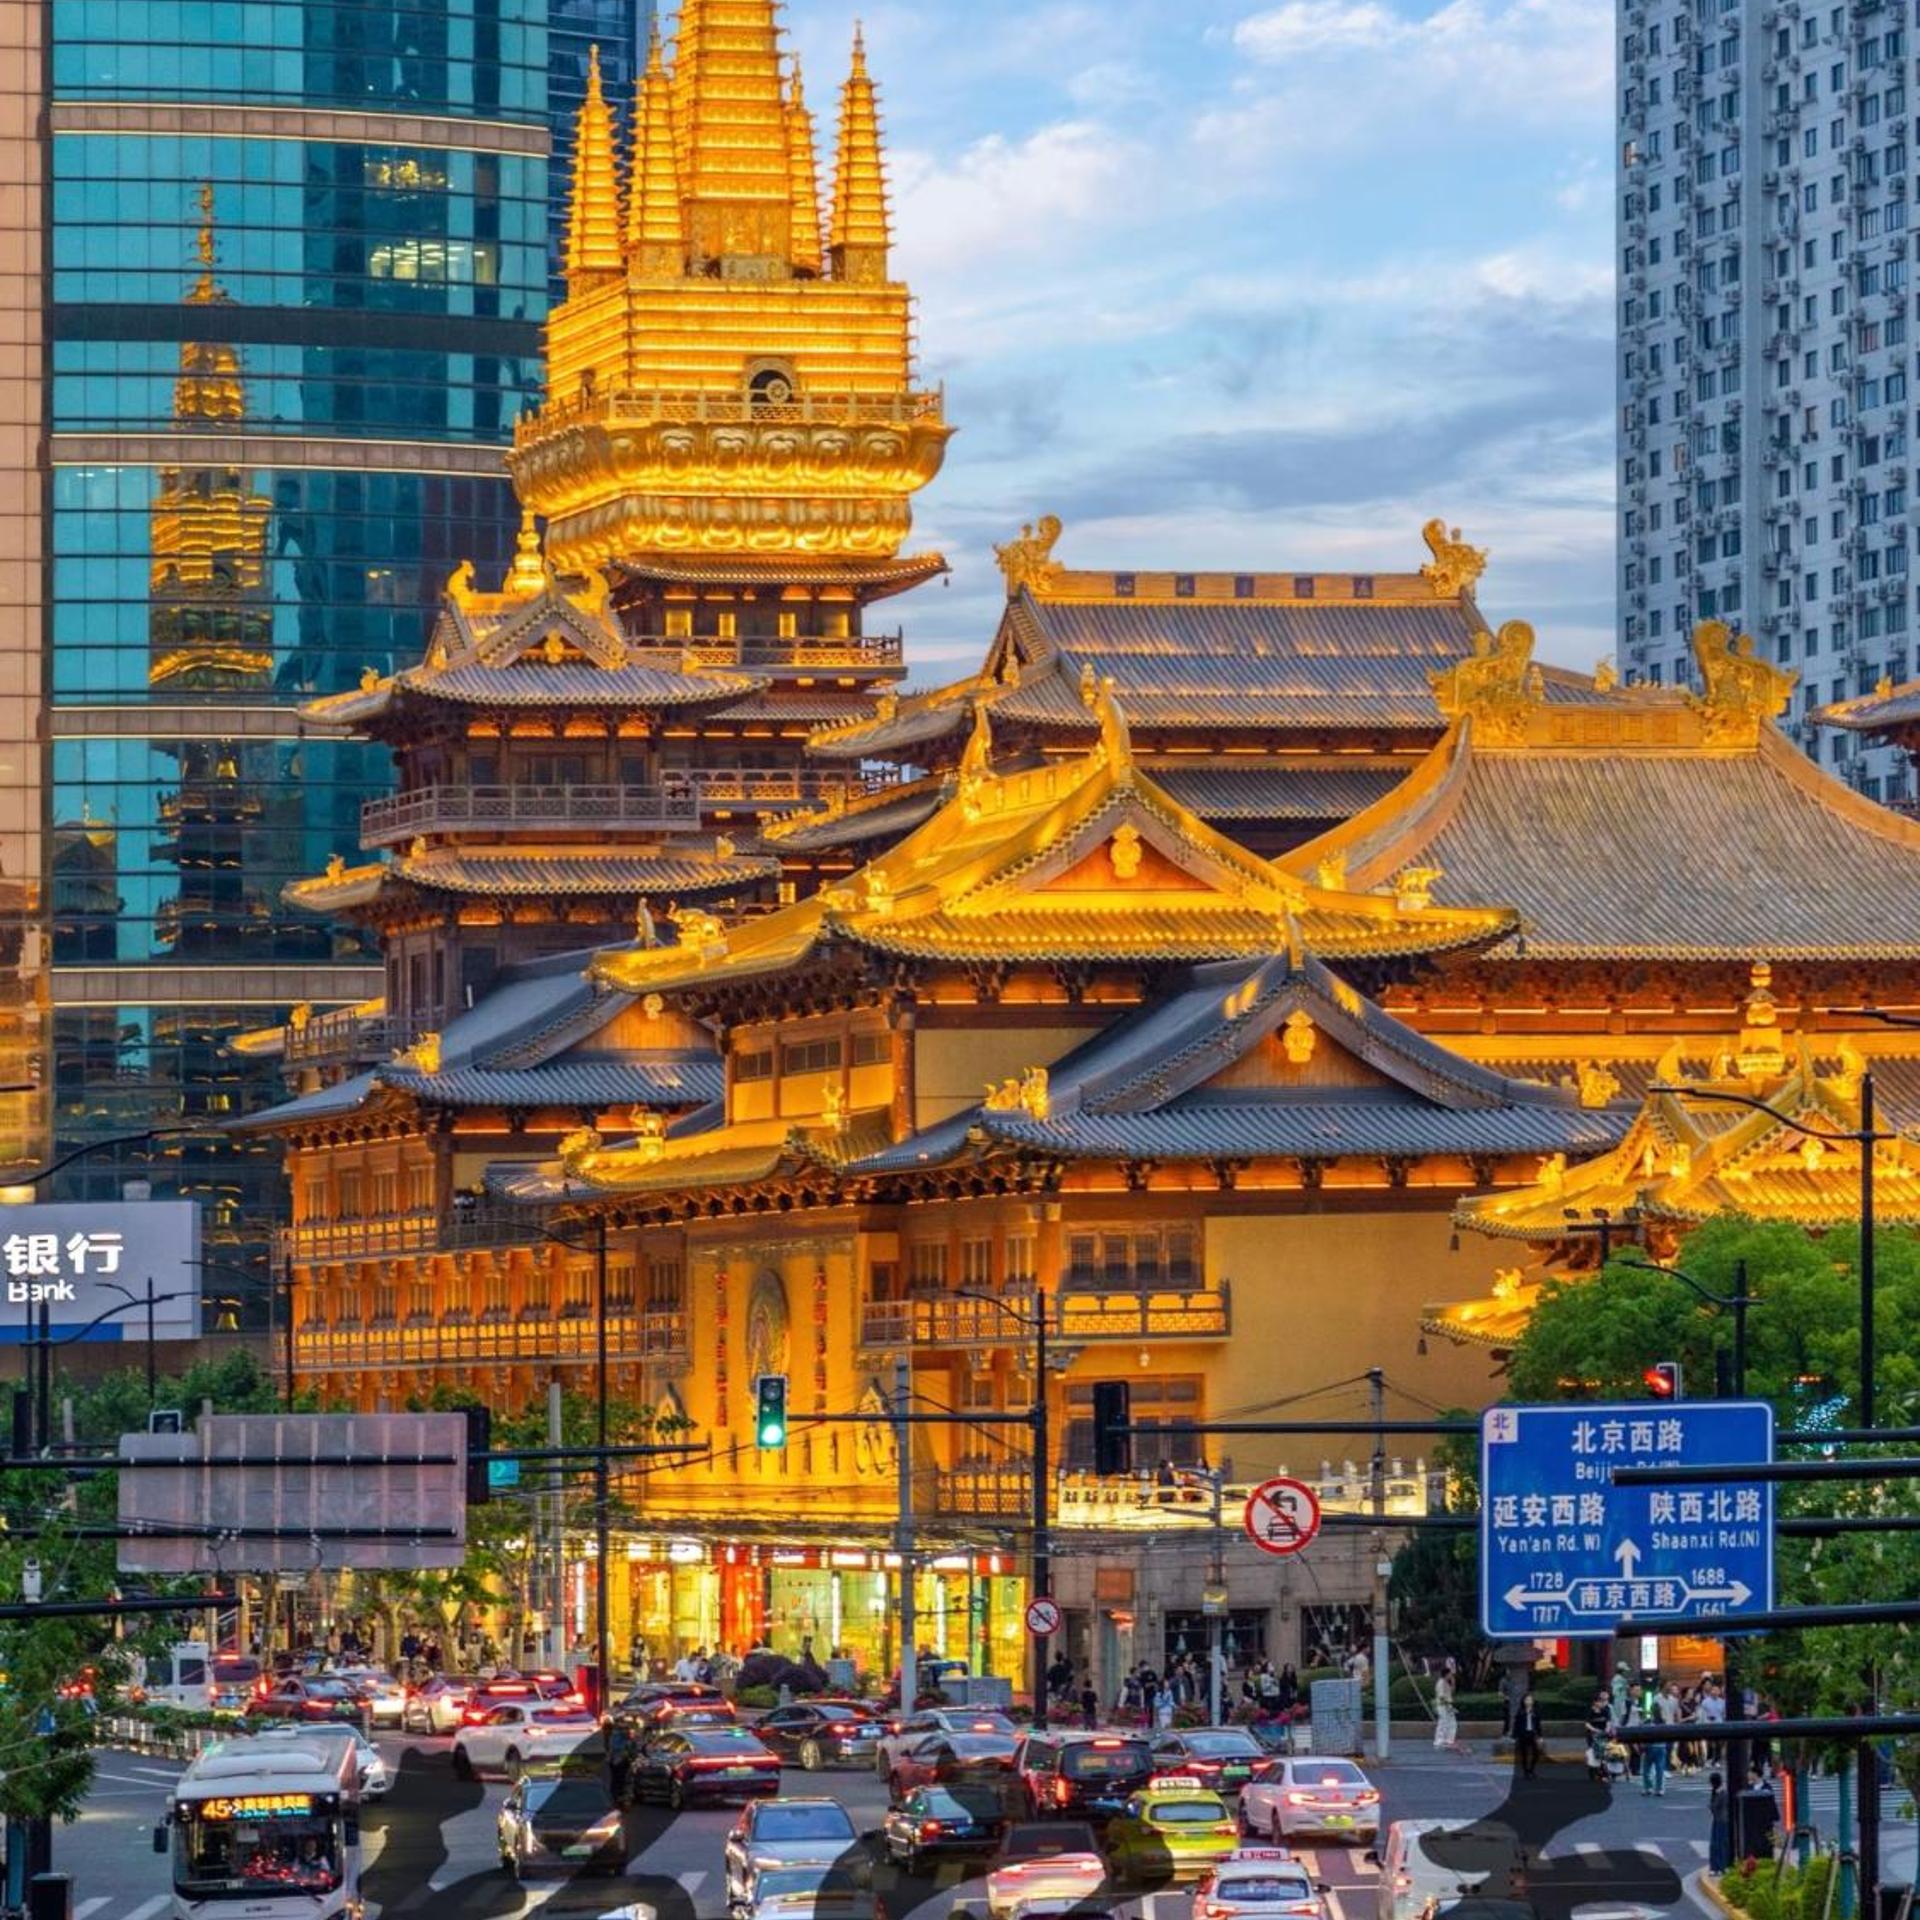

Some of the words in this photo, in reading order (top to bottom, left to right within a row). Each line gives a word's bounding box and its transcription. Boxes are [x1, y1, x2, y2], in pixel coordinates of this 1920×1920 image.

[3, 1233, 124, 1275] 银行
[8, 1279, 76, 1302] Bank
[1493, 1414, 1510, 1430] 北
[1571, 1419, 1684, 1454] 北京西路
[1493, 1493, 1605, 1529] 延安西路
[1650, 1489, 1762, 1525] 陕西北路
[1498, 1536, 1551, 1553] Yan'an
[1651, 1531, 1714, 1550] Shaanxi
[1719, 1529, 1760, 1548] Rd.(N)
[1530, 1572, 1564, 1590] 1728
[1692, 1568, 1726, 1586] 1688
[1579, 1582, 1676, 1610] 南京西路
[1532, 1606, 1560, 1624] 1717
[202, 1800, 229, 1819] 45
